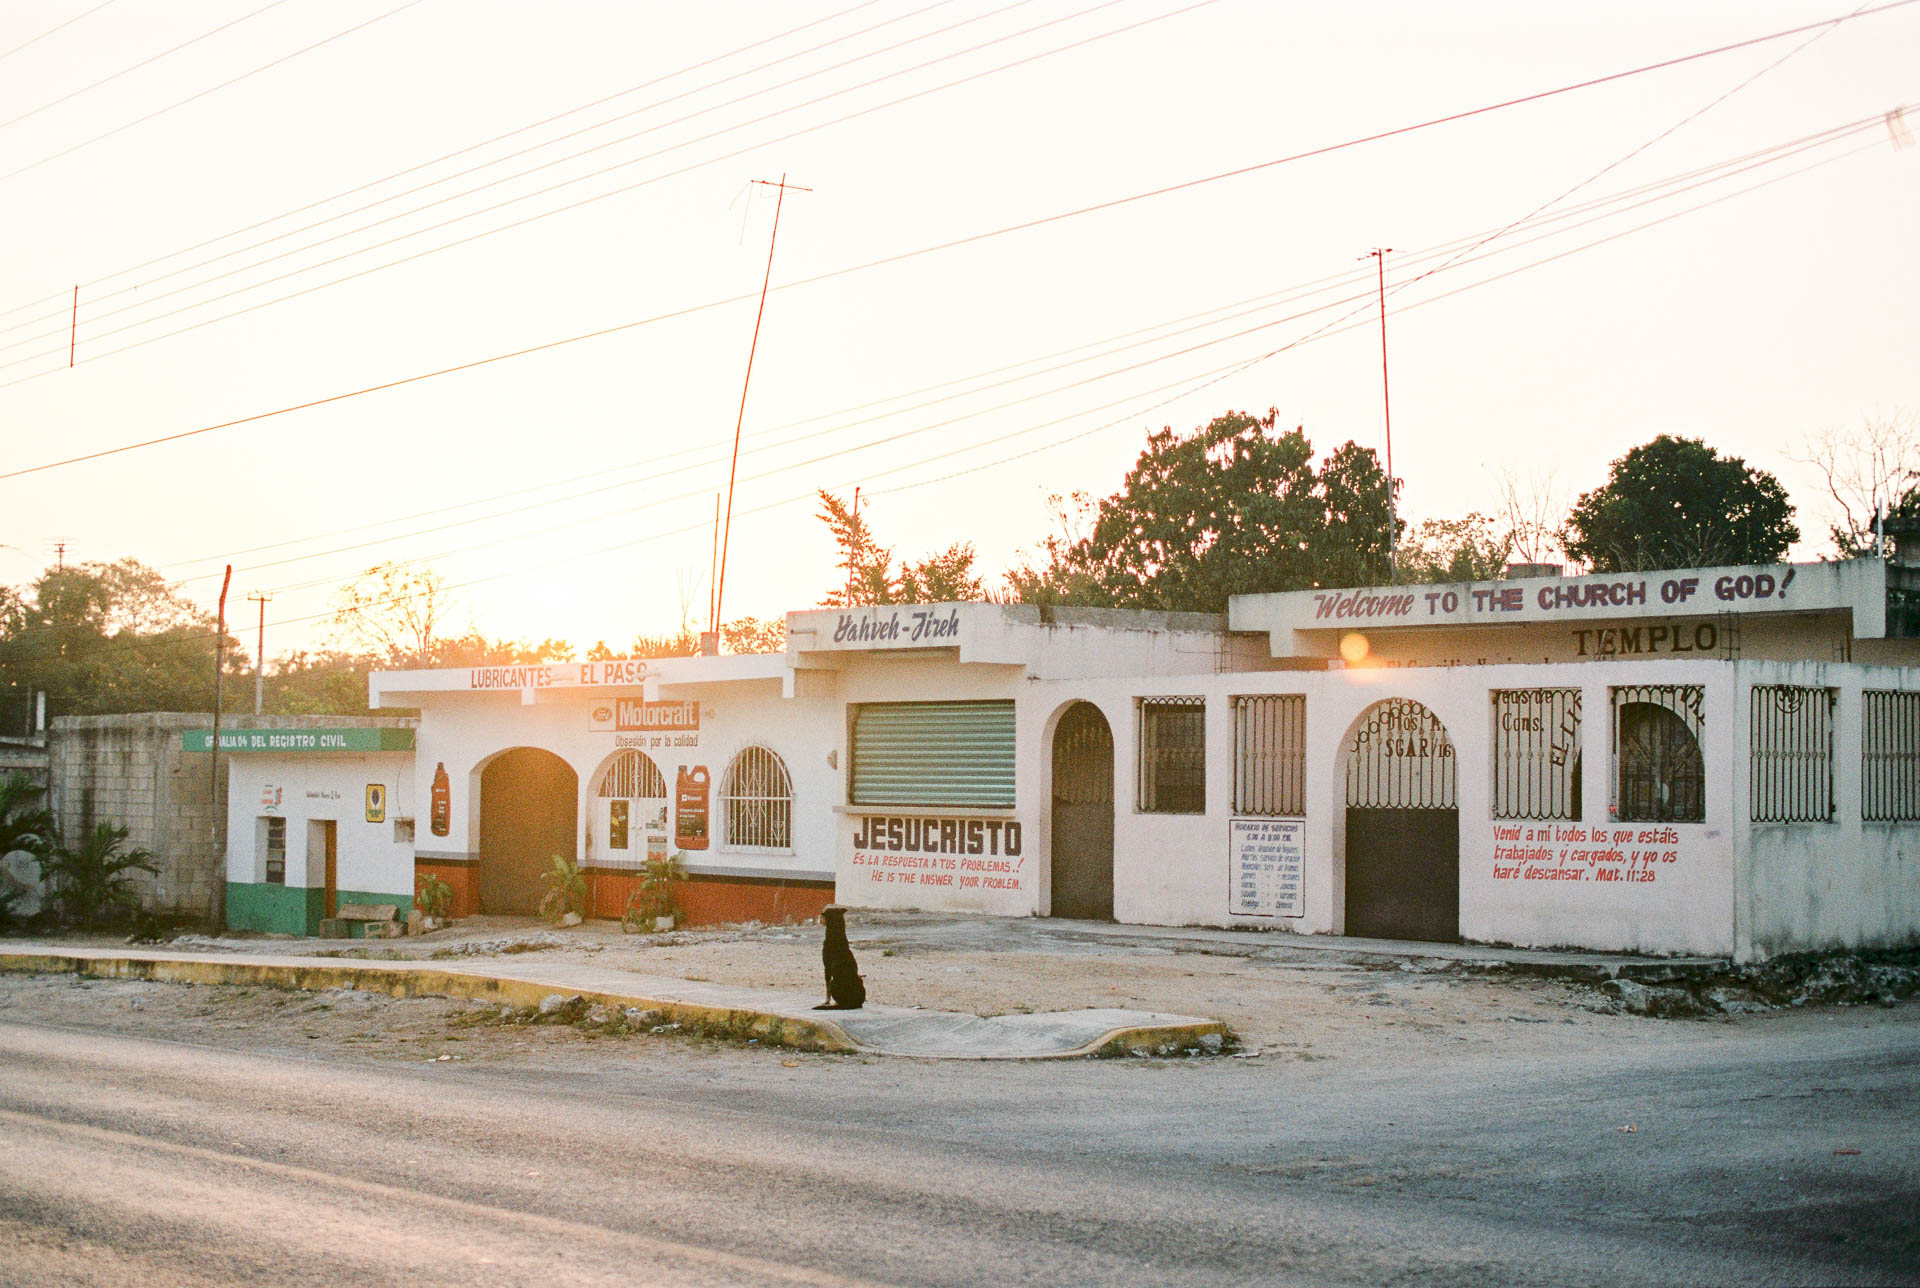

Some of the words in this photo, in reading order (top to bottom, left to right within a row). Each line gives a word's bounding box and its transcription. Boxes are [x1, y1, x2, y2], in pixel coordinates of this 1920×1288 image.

[1314, 590, 1415, 619] Welcome
[1425, 592, 1458, 615] TO
[1472, 588, 1523, 612] THE
[1538, 580, 1646, 610] CHURCH
[1661, 578, 1699, 604] OF
[1714, 568, 1796, 601] GOD!
[1571, 623, 1717, 656] TEMPLO
[471, 667, 552, 688] LUBRICANTES
[581, 664, 599, 684] EL
[604, 662, 647, 683] PASO
[620, 700, 697, 726] Motorcraft
[252, 735, 266, 748] DEL
[270, 735, 315, 748] REGISTRO
[320, 734, 347, 748] CIVIL
[616, 734, 647, 747] Obsesión
[651, 737, 661, 750] por
[665, 735, 671, 747] la
[674, 734, 699, 747] calidad
[853, 817, 1022, 857] JESUCRISTO
[1494, 824, 1522, 841] Venid
[1526, 829, 1534, 841] a
[1555, 824, 1587, 842] todos
[1591, 826, 1608, 843] los
[1613, 830, 1633, 848] que
[867, 854, 879, 866] LA
[882, 855, 929, 869] RESPUESTA
[931, 857, 937, 869] A
[940, 858, 956, 870] TUS
[1494, 844, 1553, 865] trabajados
[1559, 849, 1568, 867] y
[1570, 847, 1627, 867] cargados,
[1631, 850, 1640, 870] y
[1642, 850, 1658, 870] yo
[1662, 850, 1677, 864] os
[872, 869, 883, 882] HE
[887, 872, 895, 883] IS
[898, 873, 916, 884] THE
[920, 873, 953, 886] ANSWER
[1494, 861, 1521, 880] haré
[1595, 868, 1623, 881] Mat.
[1626, 869, 1656, 883] 11:28
